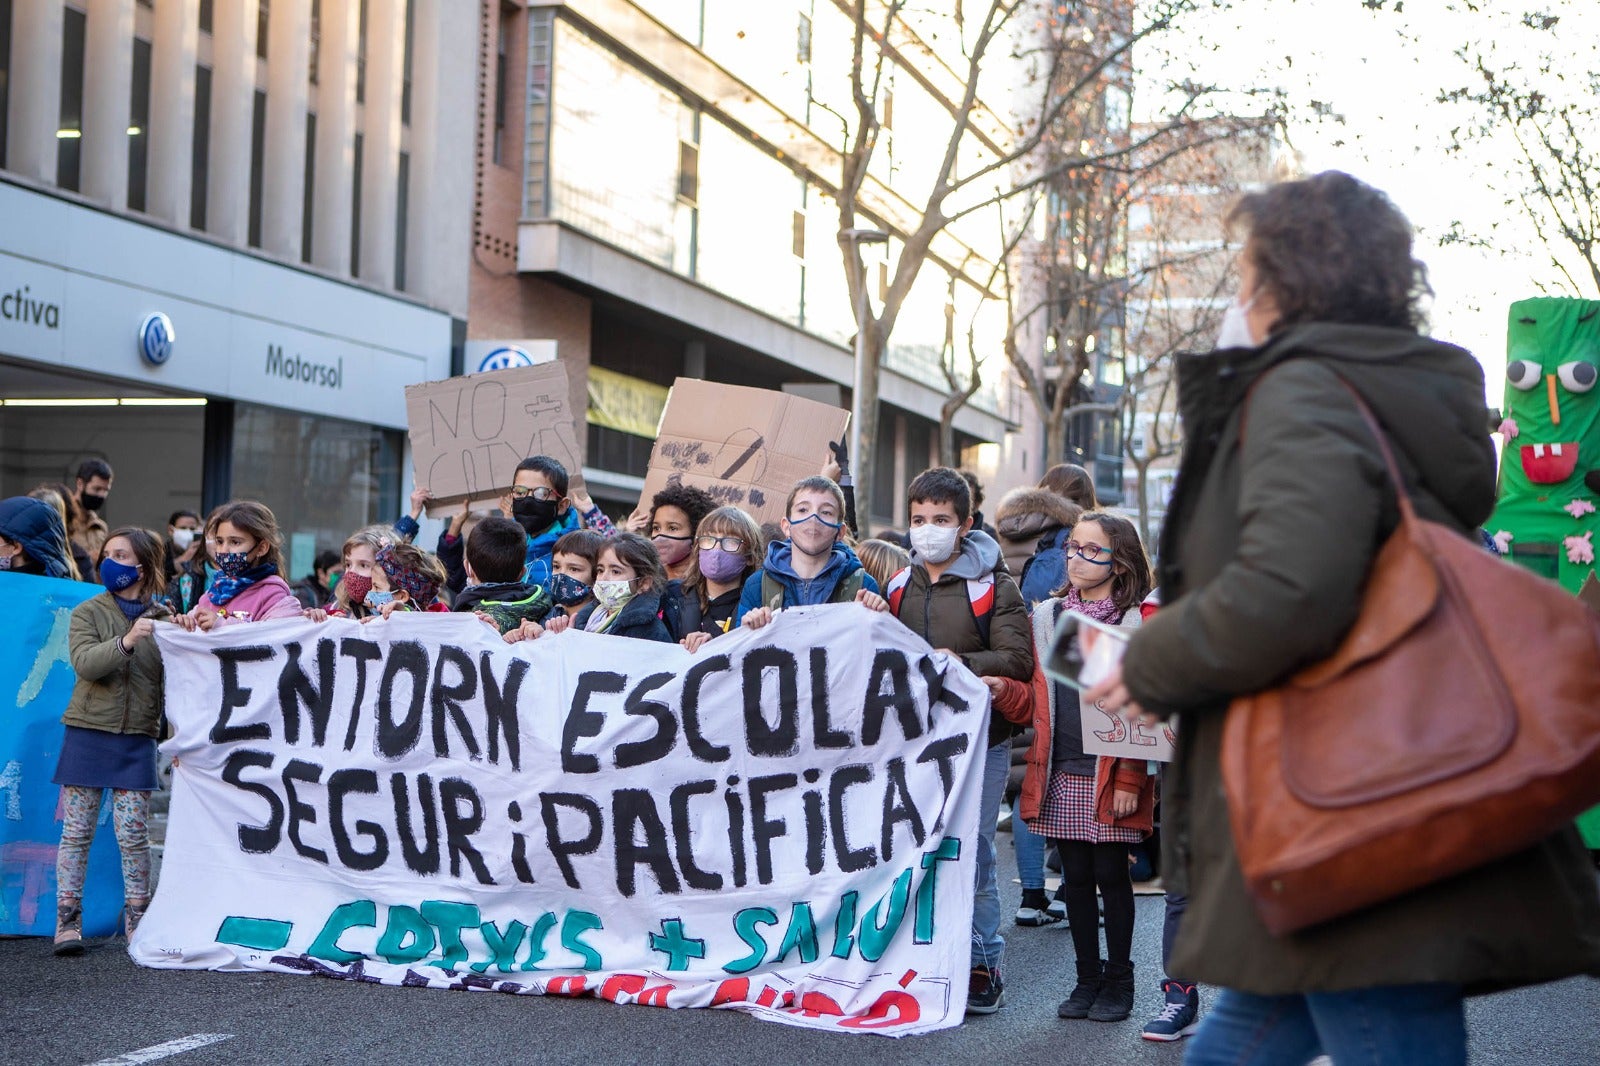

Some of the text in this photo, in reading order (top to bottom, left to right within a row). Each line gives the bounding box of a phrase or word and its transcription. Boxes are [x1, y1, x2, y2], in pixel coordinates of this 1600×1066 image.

[1, 285, 59, 329] ctiva
[265, 344, 343, 390] Motorsol
[429, 380, 507, 446] NO
[209, 637, 531, 772] ENTORN
[221, 748, 498, 886] SEGUR
